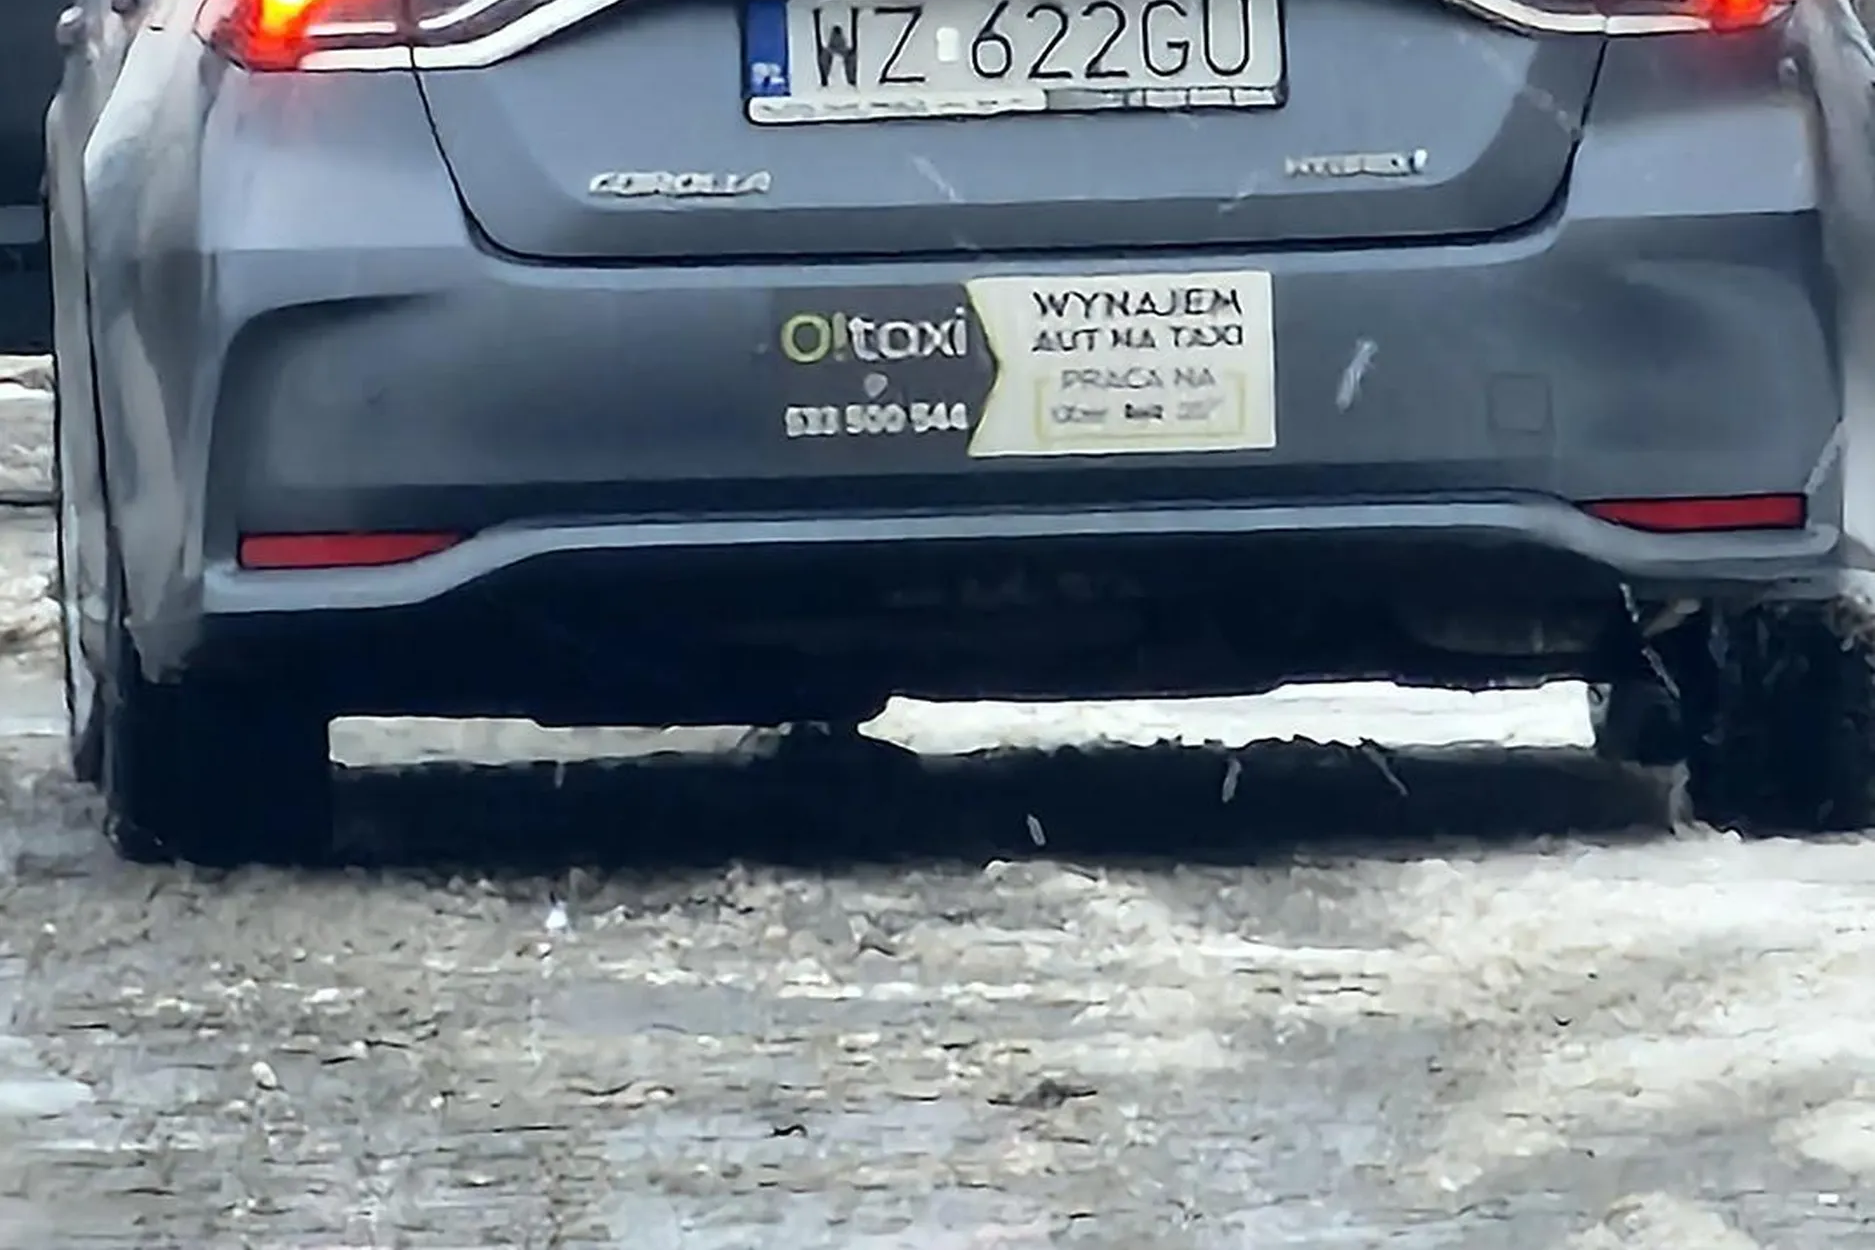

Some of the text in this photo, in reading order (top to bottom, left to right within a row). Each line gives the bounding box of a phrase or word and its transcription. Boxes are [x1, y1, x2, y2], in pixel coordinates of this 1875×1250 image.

[812, 5, 927, 88] WZ
[1032, 288, 1244, 319] WYNAJEM
[1031, 323, 1244, 352] AUT NA TAXI
